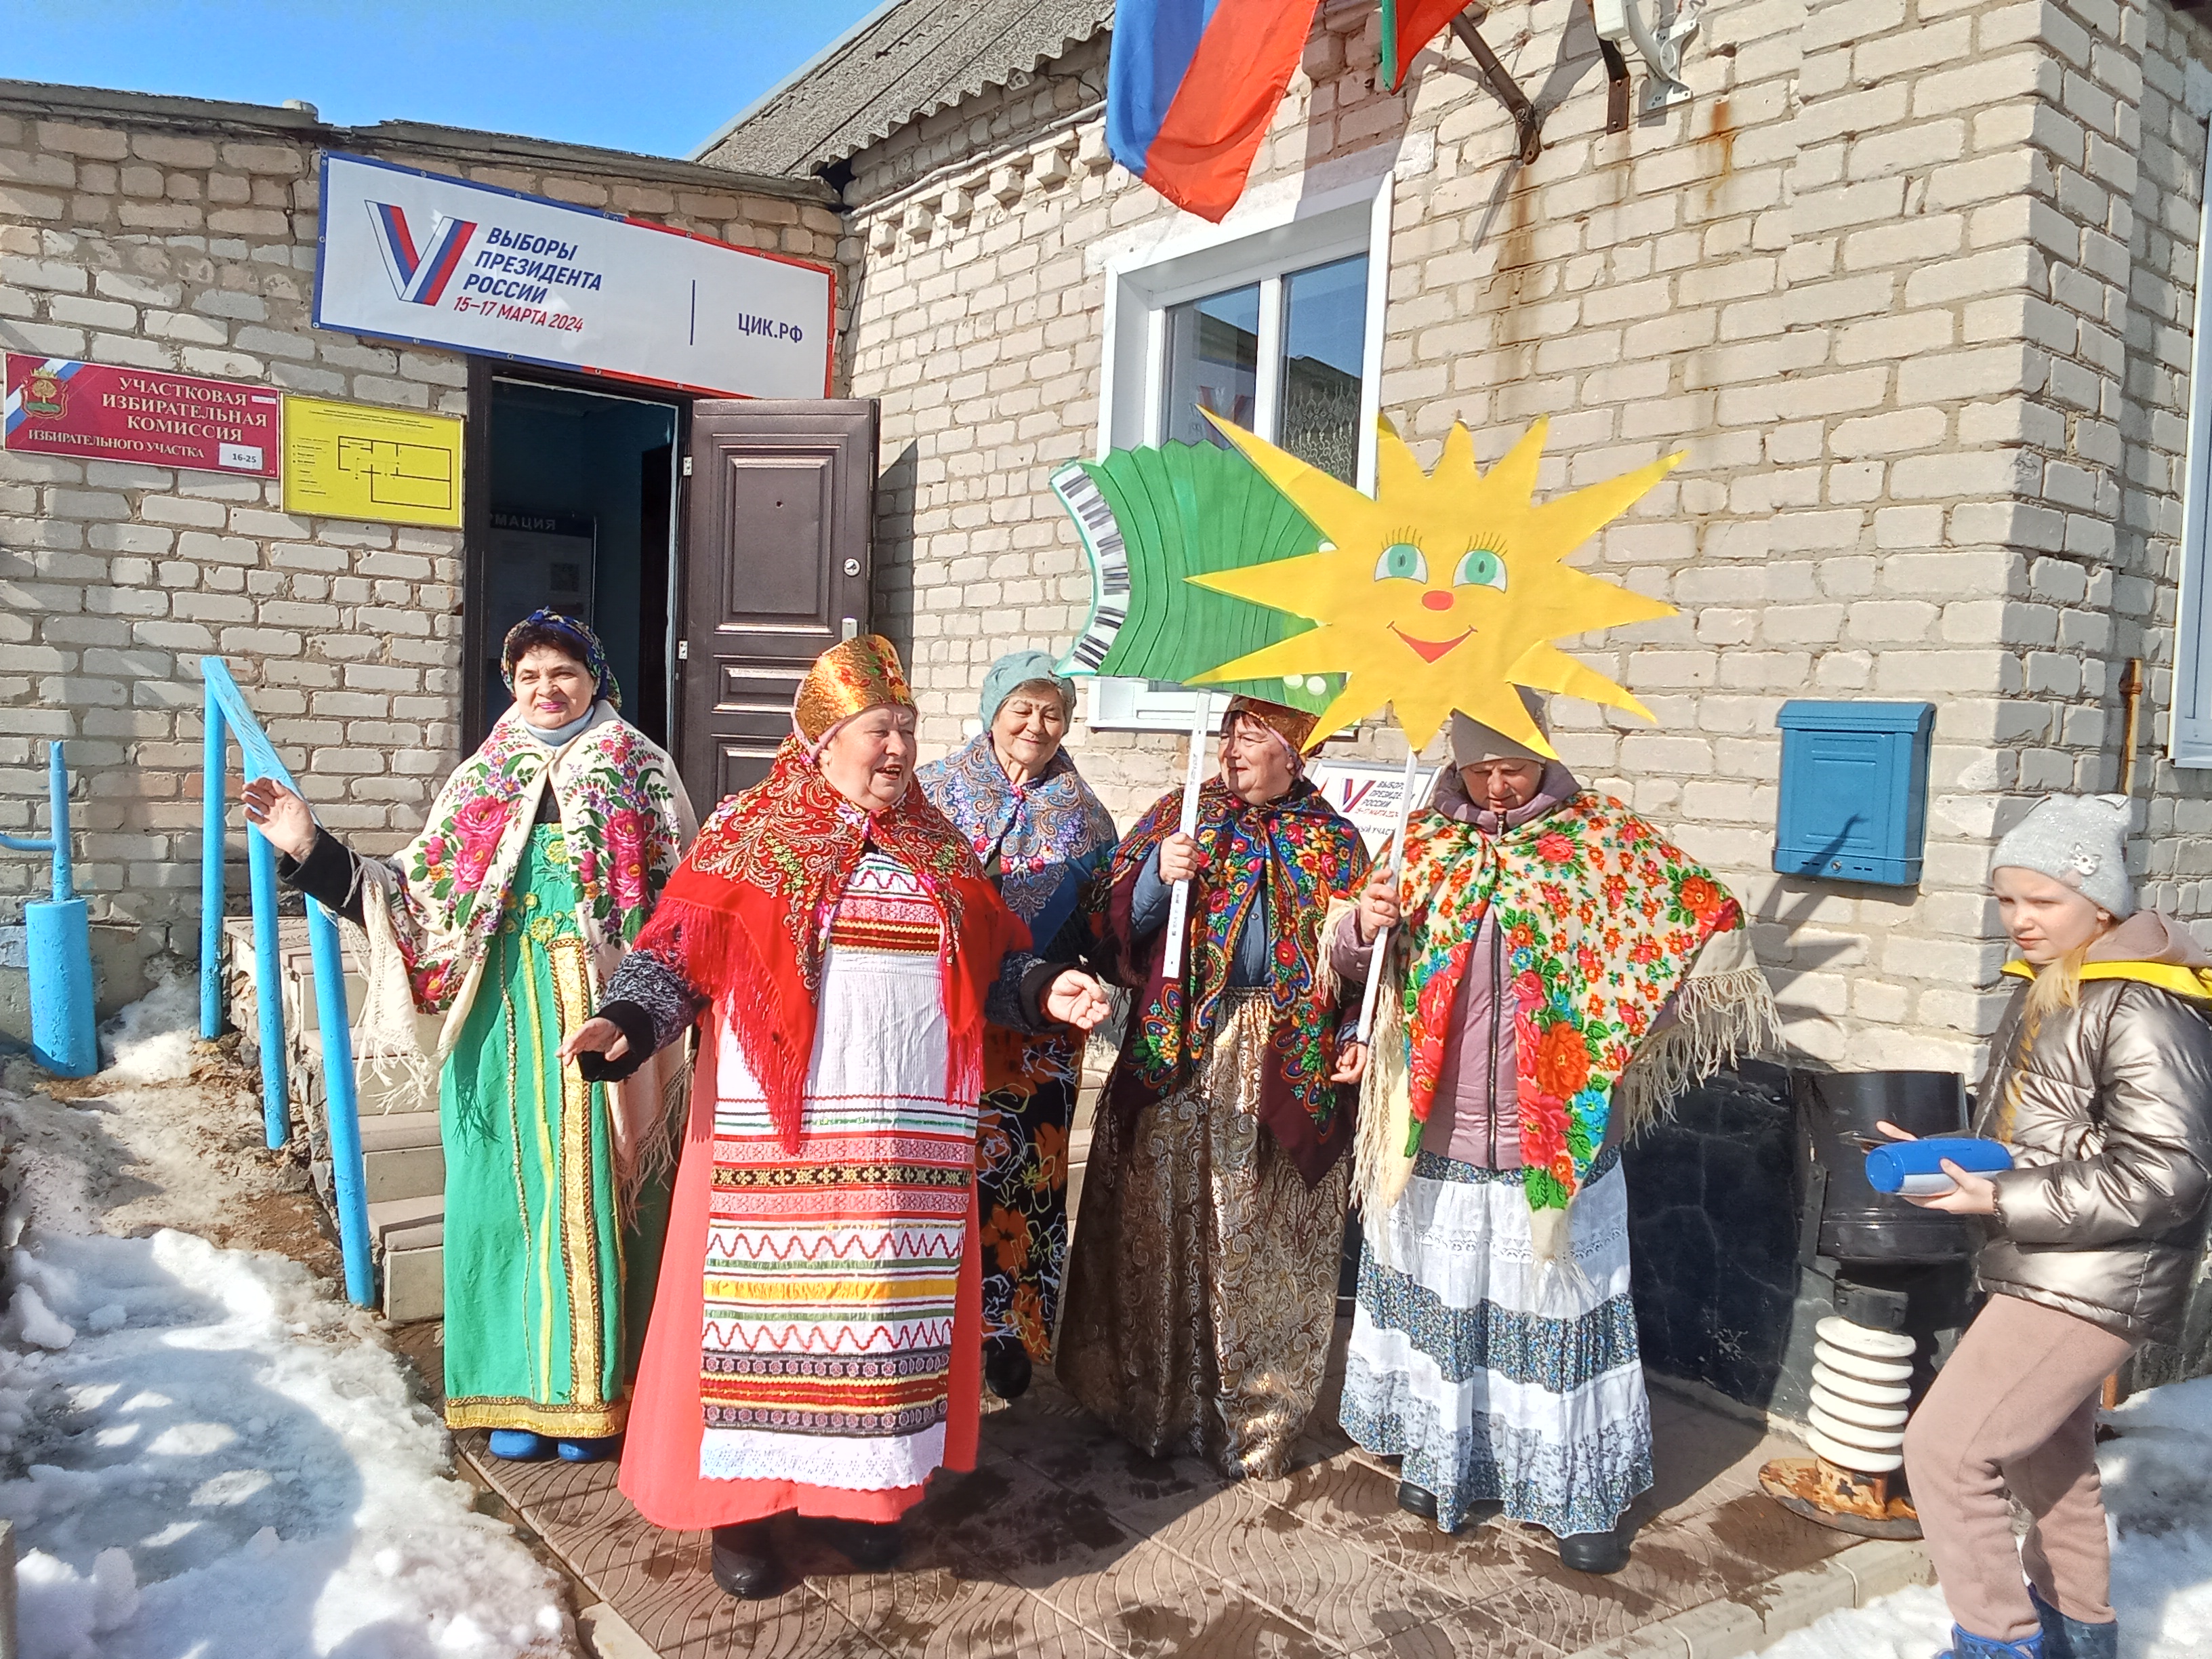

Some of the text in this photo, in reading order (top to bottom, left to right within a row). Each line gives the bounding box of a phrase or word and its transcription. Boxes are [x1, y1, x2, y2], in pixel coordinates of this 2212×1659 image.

[486, 227, 579, 261] ВЫБОРЫ
[474, 250, 602, 291] ПРЕЗИДЕНТА
[462, 273, 548, 304] РОССИИ
[496, 303, 548, 327] МАРТА
[548, 312, 584, 333] 2024
[737, 312, 804, 344] ЦИК.РФ
[119, 377, 247, 407] УЧАСТКОВАЯ
[102, 393, 268, 428] ИЗБИРАТЕЛЬНАЯ
[28, 428, 205, 459] ИЗБИРАТЕЛЬНОГО УЧАСТКА
[127, 415, 243, 442] КОМИССИЯ
[232, 452, 257, 464] 16-25
[491, 514, 556, 531] МАЦИЯ
[1368, 790, 1416, 800] ПРЕЗИДЕ
[1376, 781, 1405, 790] ВЫБОР
